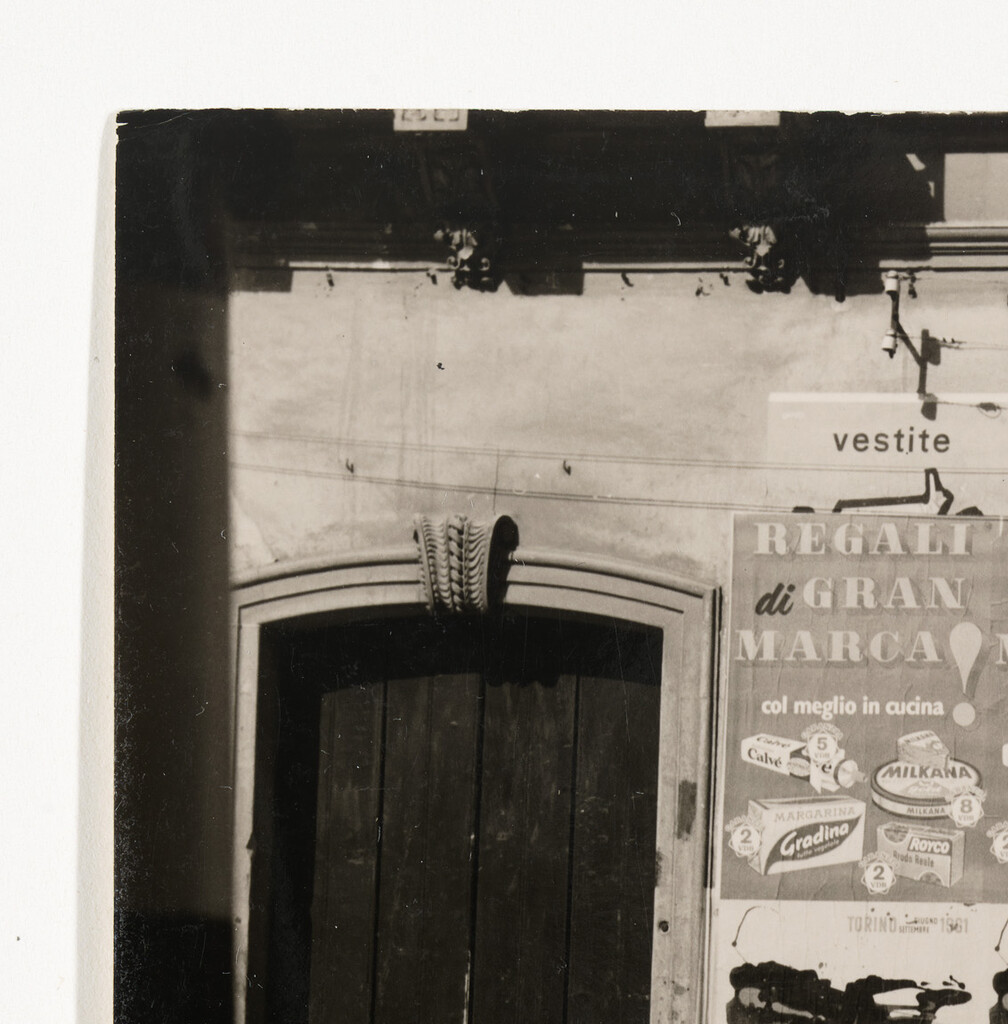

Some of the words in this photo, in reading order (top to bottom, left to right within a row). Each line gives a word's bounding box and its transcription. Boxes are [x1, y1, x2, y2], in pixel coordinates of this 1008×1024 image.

[833, 427, 951, 453] vestite
[752, 522, 973, 557] REGALI
[754, 582, 796, 616] di
[802, 577, 968, 612] GRAN
[761, 697, 790, 715] col
[794, 696, 858, 721] meglio
[862, 697, 880, 715] in
[885, 698, 945, 716] cucina
[817, 736, 828, 751] 5
[747, 747, 782, 768] Calvé
[881, 765, 972, 779] MILKANA
[774, 806, 856, 823] MARGARINA
[960, 798, 973, 814] 8
[740, 829, 752, 844] 2
[780, 822, 850, 857] Gradina
[909, 837, 950, 854] ROYCO
[873, 865, 885, 880] 2
[847, 915, 897, 934] TORINO
